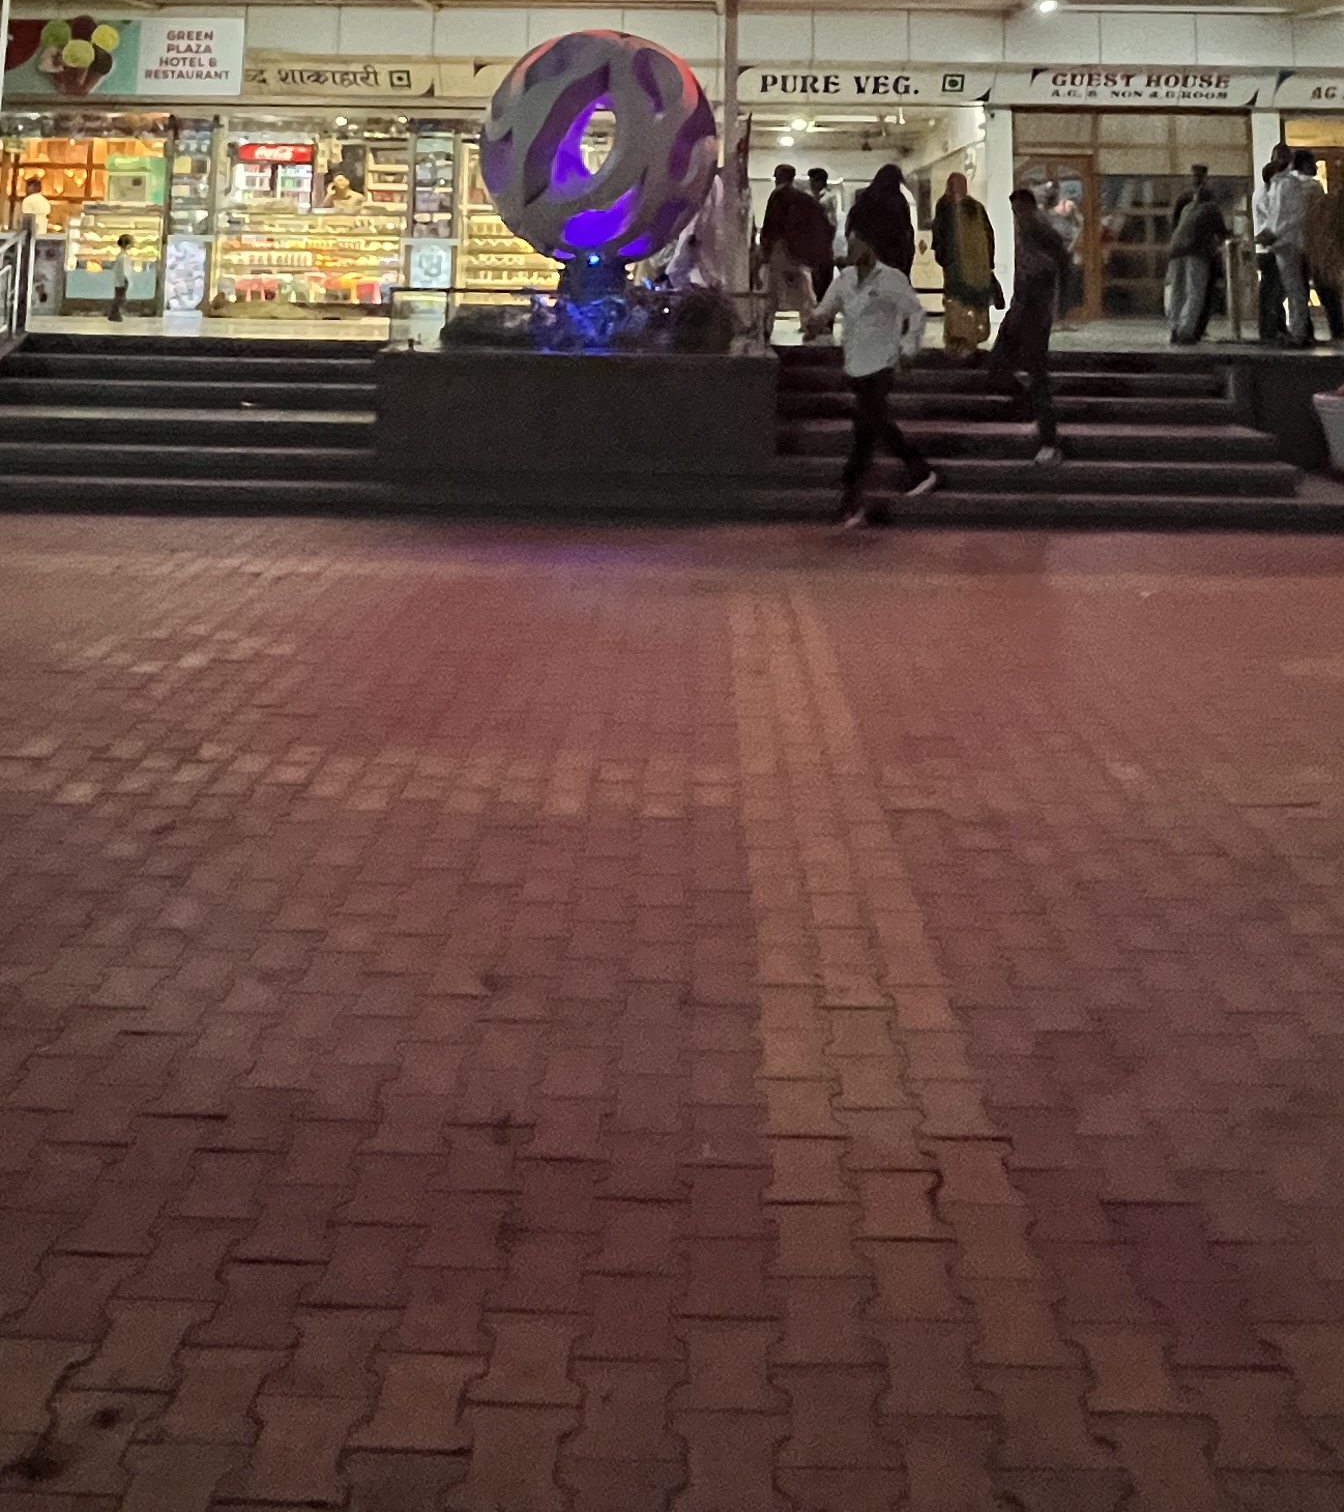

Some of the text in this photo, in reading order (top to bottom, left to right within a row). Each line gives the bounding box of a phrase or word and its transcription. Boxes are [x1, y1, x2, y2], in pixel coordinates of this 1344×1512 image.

[166, 30, 214, 41] GREEN
[166, 43, 212, 54] PLAZA
[159, 56, 205, 67] HOTEL
[144, 69, 230, 80] RESTAURANT
[760, 74, 919, 95] PURE VEG.
[1052, 73, 1230, 89] GUEST HOUSE
[1111, 90, 1143, 99] NON
